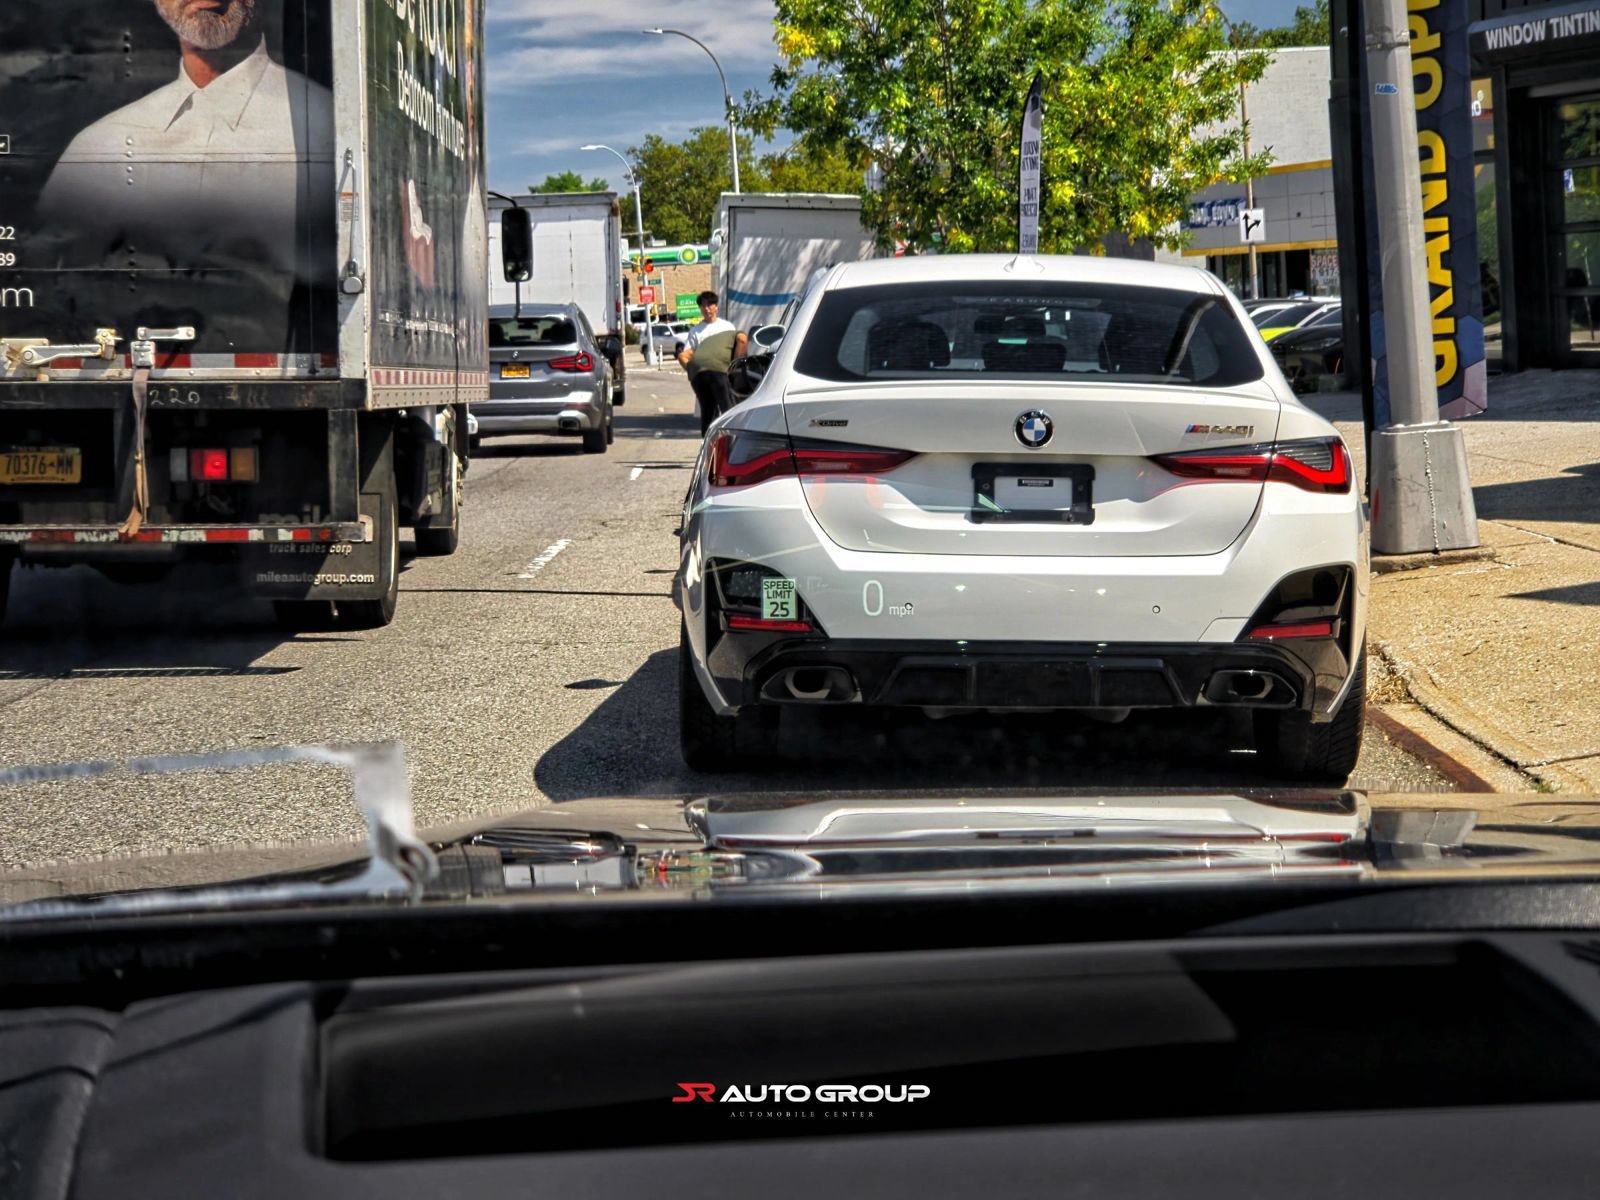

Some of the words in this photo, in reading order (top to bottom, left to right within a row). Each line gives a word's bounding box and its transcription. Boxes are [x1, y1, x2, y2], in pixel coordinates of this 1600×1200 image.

[1485, 19, 1546, 50] WINDOW
[397, 40, 435, 136] Bedroom
[299, 543, 326, 553] sales
[329, 544, 352, 555] corp
[763, 580, 795, 590] SPEED
[766, 590, 792, 599] LIMIT
[862, 579, 884, 617] 0
[888, 603, 915, 617] mph
[769, 601, 790, 617] 25
